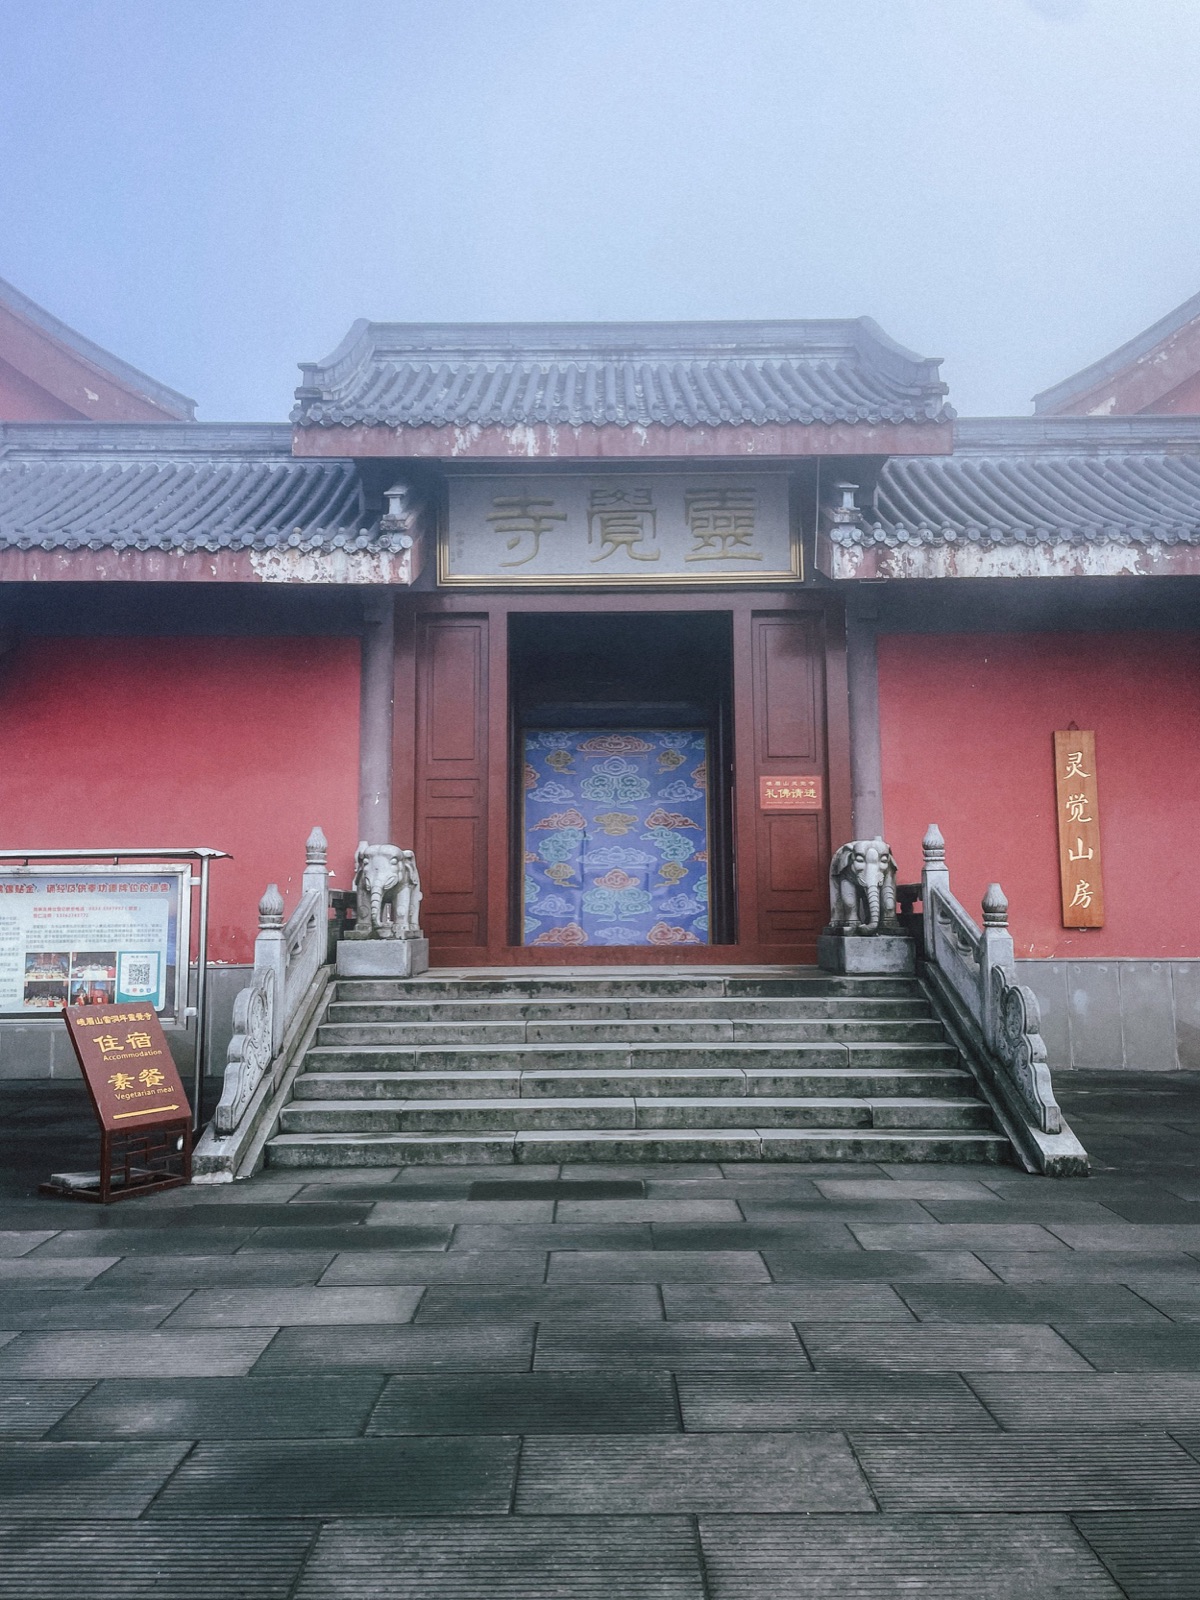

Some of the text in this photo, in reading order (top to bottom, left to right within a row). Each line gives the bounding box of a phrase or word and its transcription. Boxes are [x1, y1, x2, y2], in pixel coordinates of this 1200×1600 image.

[764, 788, 818, 799] 礼佛请进
[1063, 751, 1094, 909] 灵觉山房
[92, 1031, 153, 1053] 住宿
[103, 1049, 163, 1062] Accommodation
[107, 1068, 165, 1091] 素餐
[114, 1086, 174, 1101] Vegetarian meal
